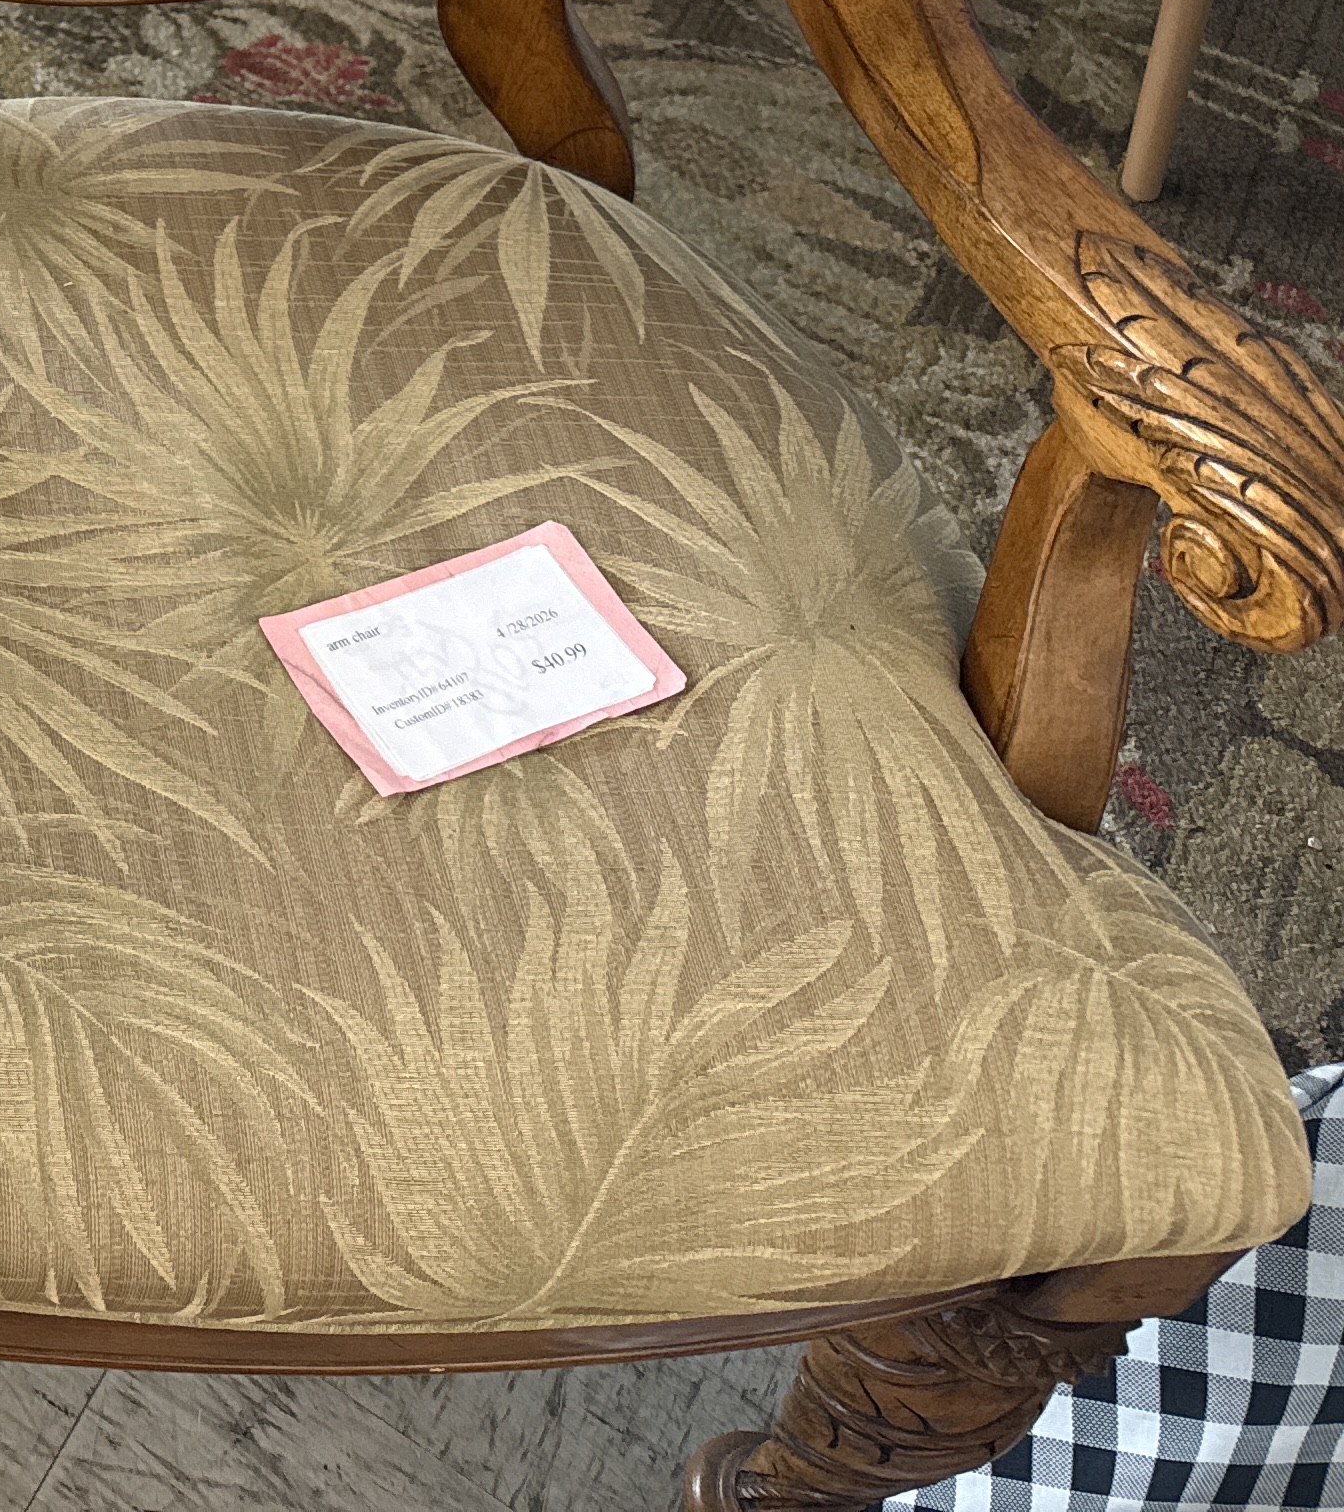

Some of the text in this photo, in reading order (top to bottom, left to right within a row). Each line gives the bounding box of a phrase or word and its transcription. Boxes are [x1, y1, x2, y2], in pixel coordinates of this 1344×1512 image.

[326, 625, 381, 652] arm chair
[530, 642, 587, 675] $40.99
